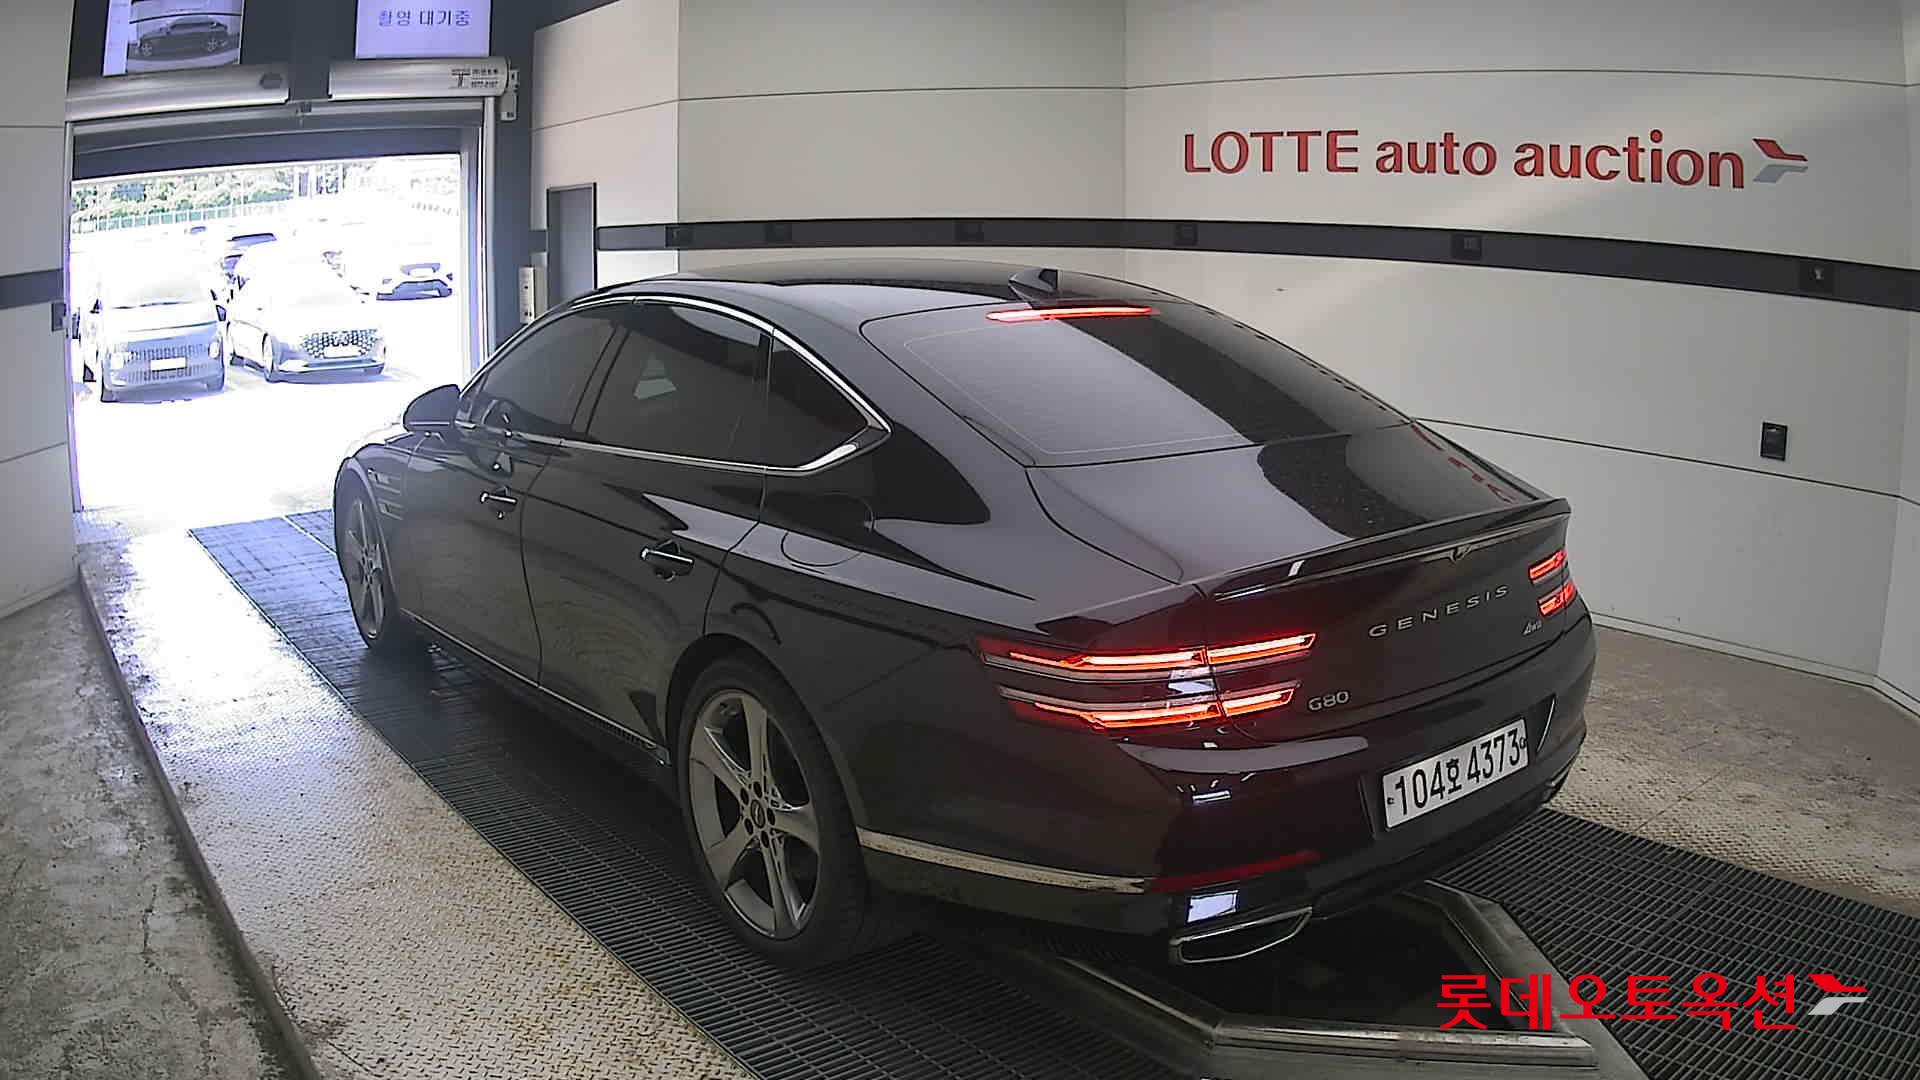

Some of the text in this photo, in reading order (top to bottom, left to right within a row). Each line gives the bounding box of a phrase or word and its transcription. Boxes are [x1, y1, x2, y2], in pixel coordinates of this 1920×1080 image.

[419, 10, 470, 26] 대기중
[1184, 129, 1744, 189] LOTTE auto auction
[1368, 584, 1510, 637] GENESIS
[1308, 691, 1350, 711] G80
[1467, 728, 1520, 783] 4373
